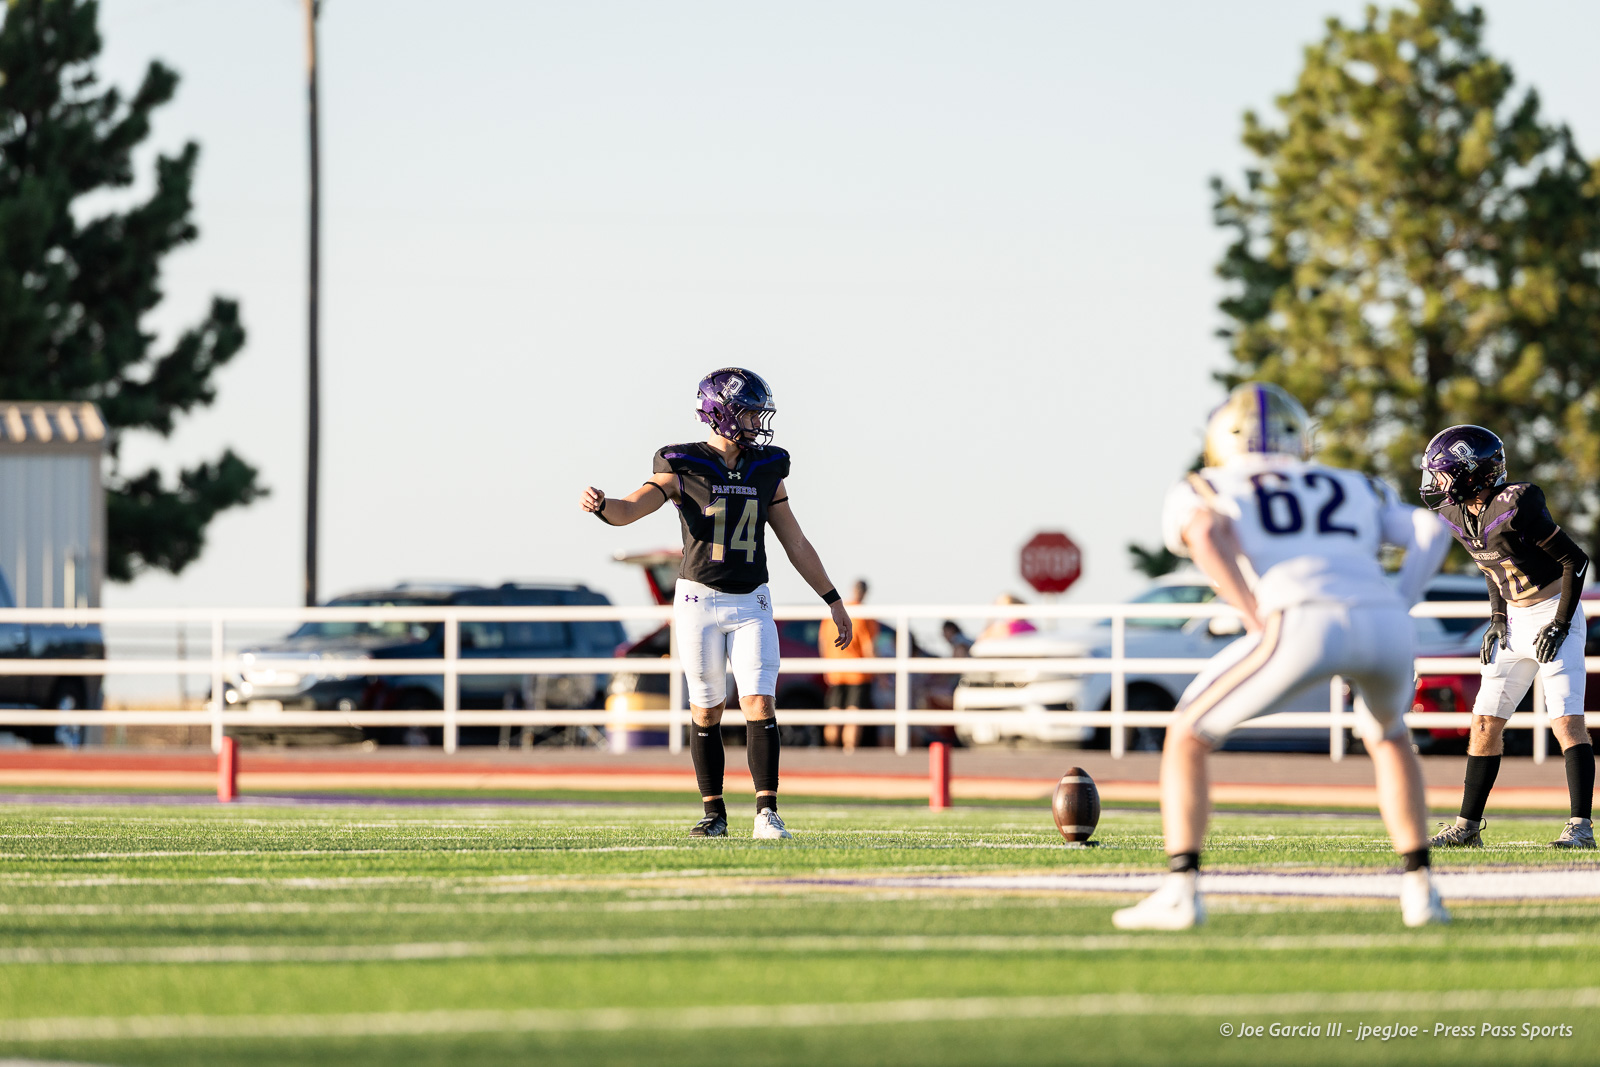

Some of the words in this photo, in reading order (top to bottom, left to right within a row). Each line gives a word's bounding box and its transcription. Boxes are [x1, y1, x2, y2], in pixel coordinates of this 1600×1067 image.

[712, 485, 757, 496] PANTHERS
[1249, 471, 1357, 535] 62
[704, 496, 759, 563] 14
[1022, 546, 1079, 579] STOP
